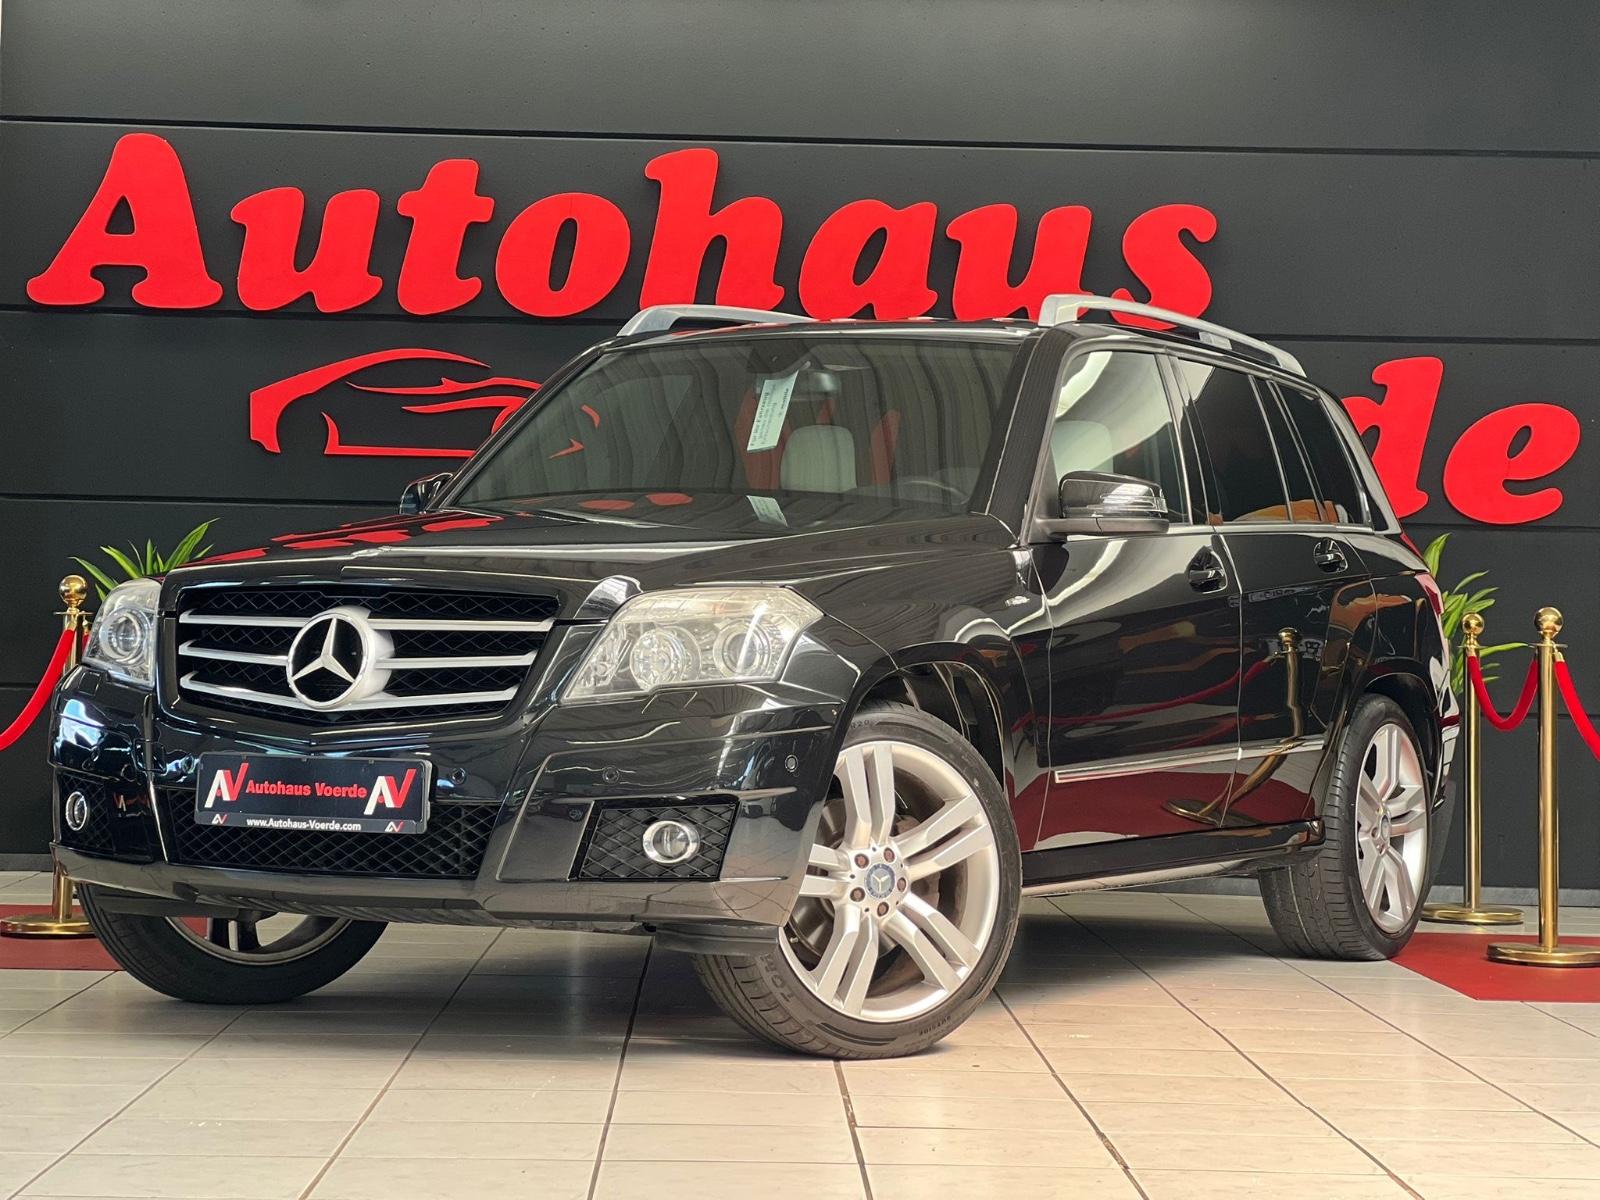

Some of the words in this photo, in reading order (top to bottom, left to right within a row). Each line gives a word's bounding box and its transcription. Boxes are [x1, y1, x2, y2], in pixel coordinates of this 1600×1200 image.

[27, 134, 1217, 320] Autohaus
[246, 780, 311, 796] Autohaus
[315, 782, 368, 798] Voerde
[246, 817, 362, 832] www.Autohaus-Voerde.com
